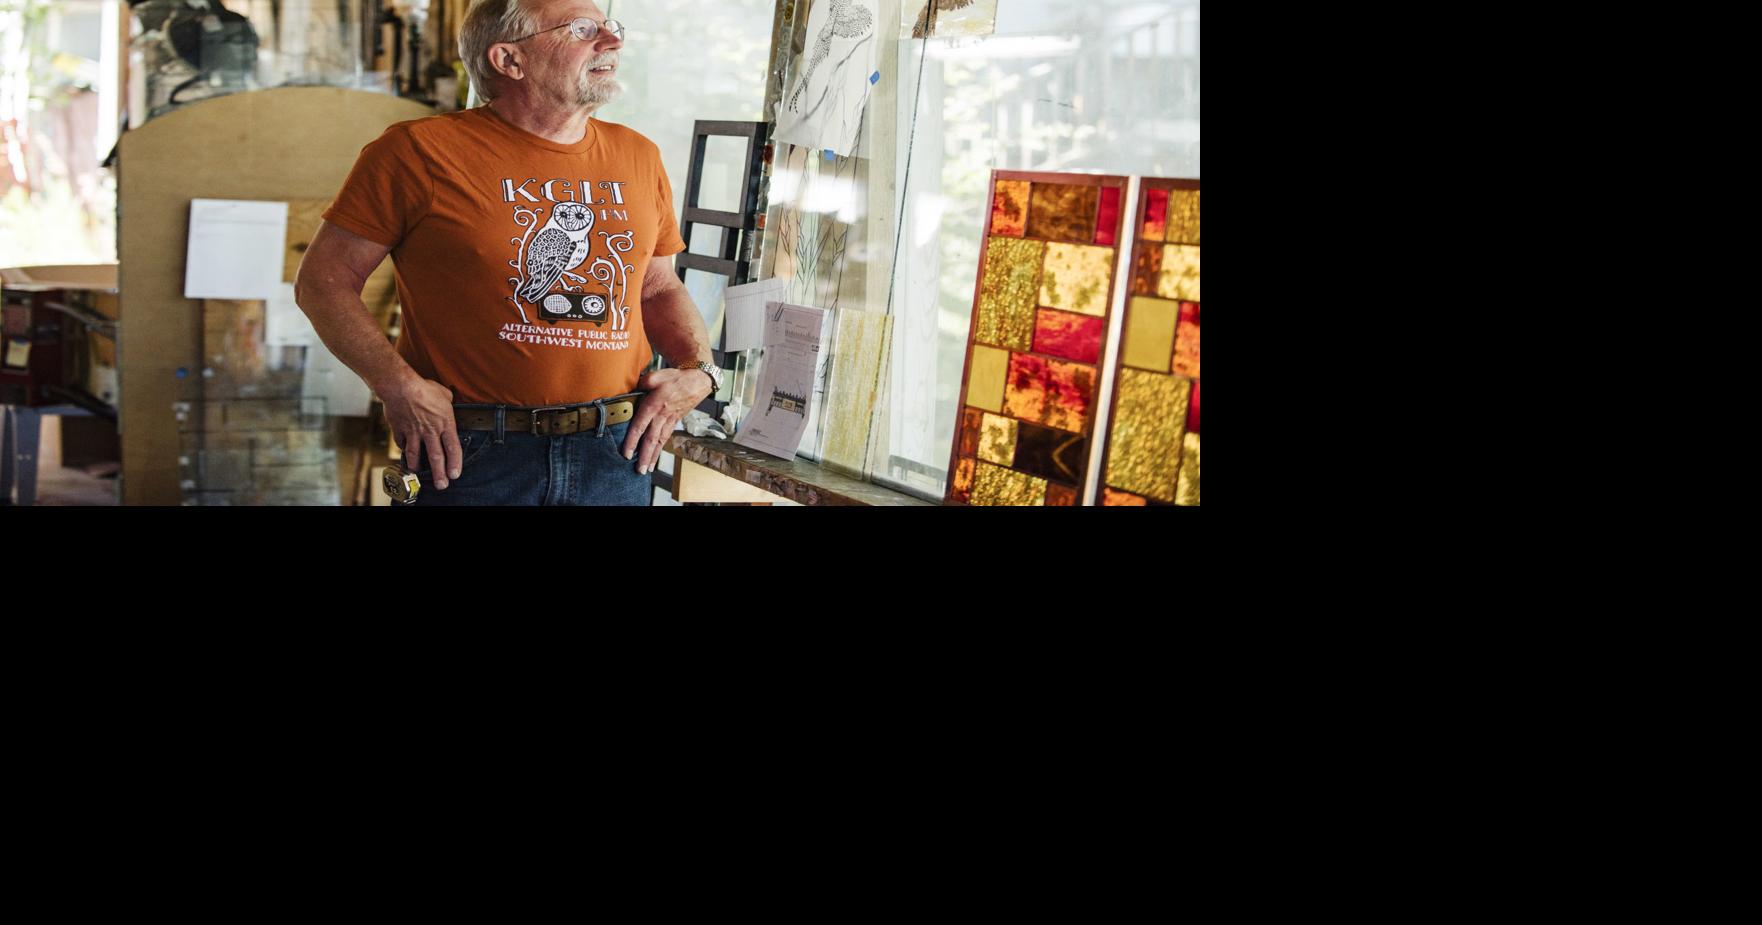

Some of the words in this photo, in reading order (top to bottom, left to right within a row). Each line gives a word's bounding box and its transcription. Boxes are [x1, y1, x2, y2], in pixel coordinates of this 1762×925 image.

[501, 178, 626, 205] KGLT
[600, 209, 628, 221] FM
[499, 331, 583, 348] SOUTHWEST
[586, 340, 629, 350] MONTAN
[501, 323, 573, 337] ALTERNATIVE
[578, 329, 608, 340] PUBLIC
